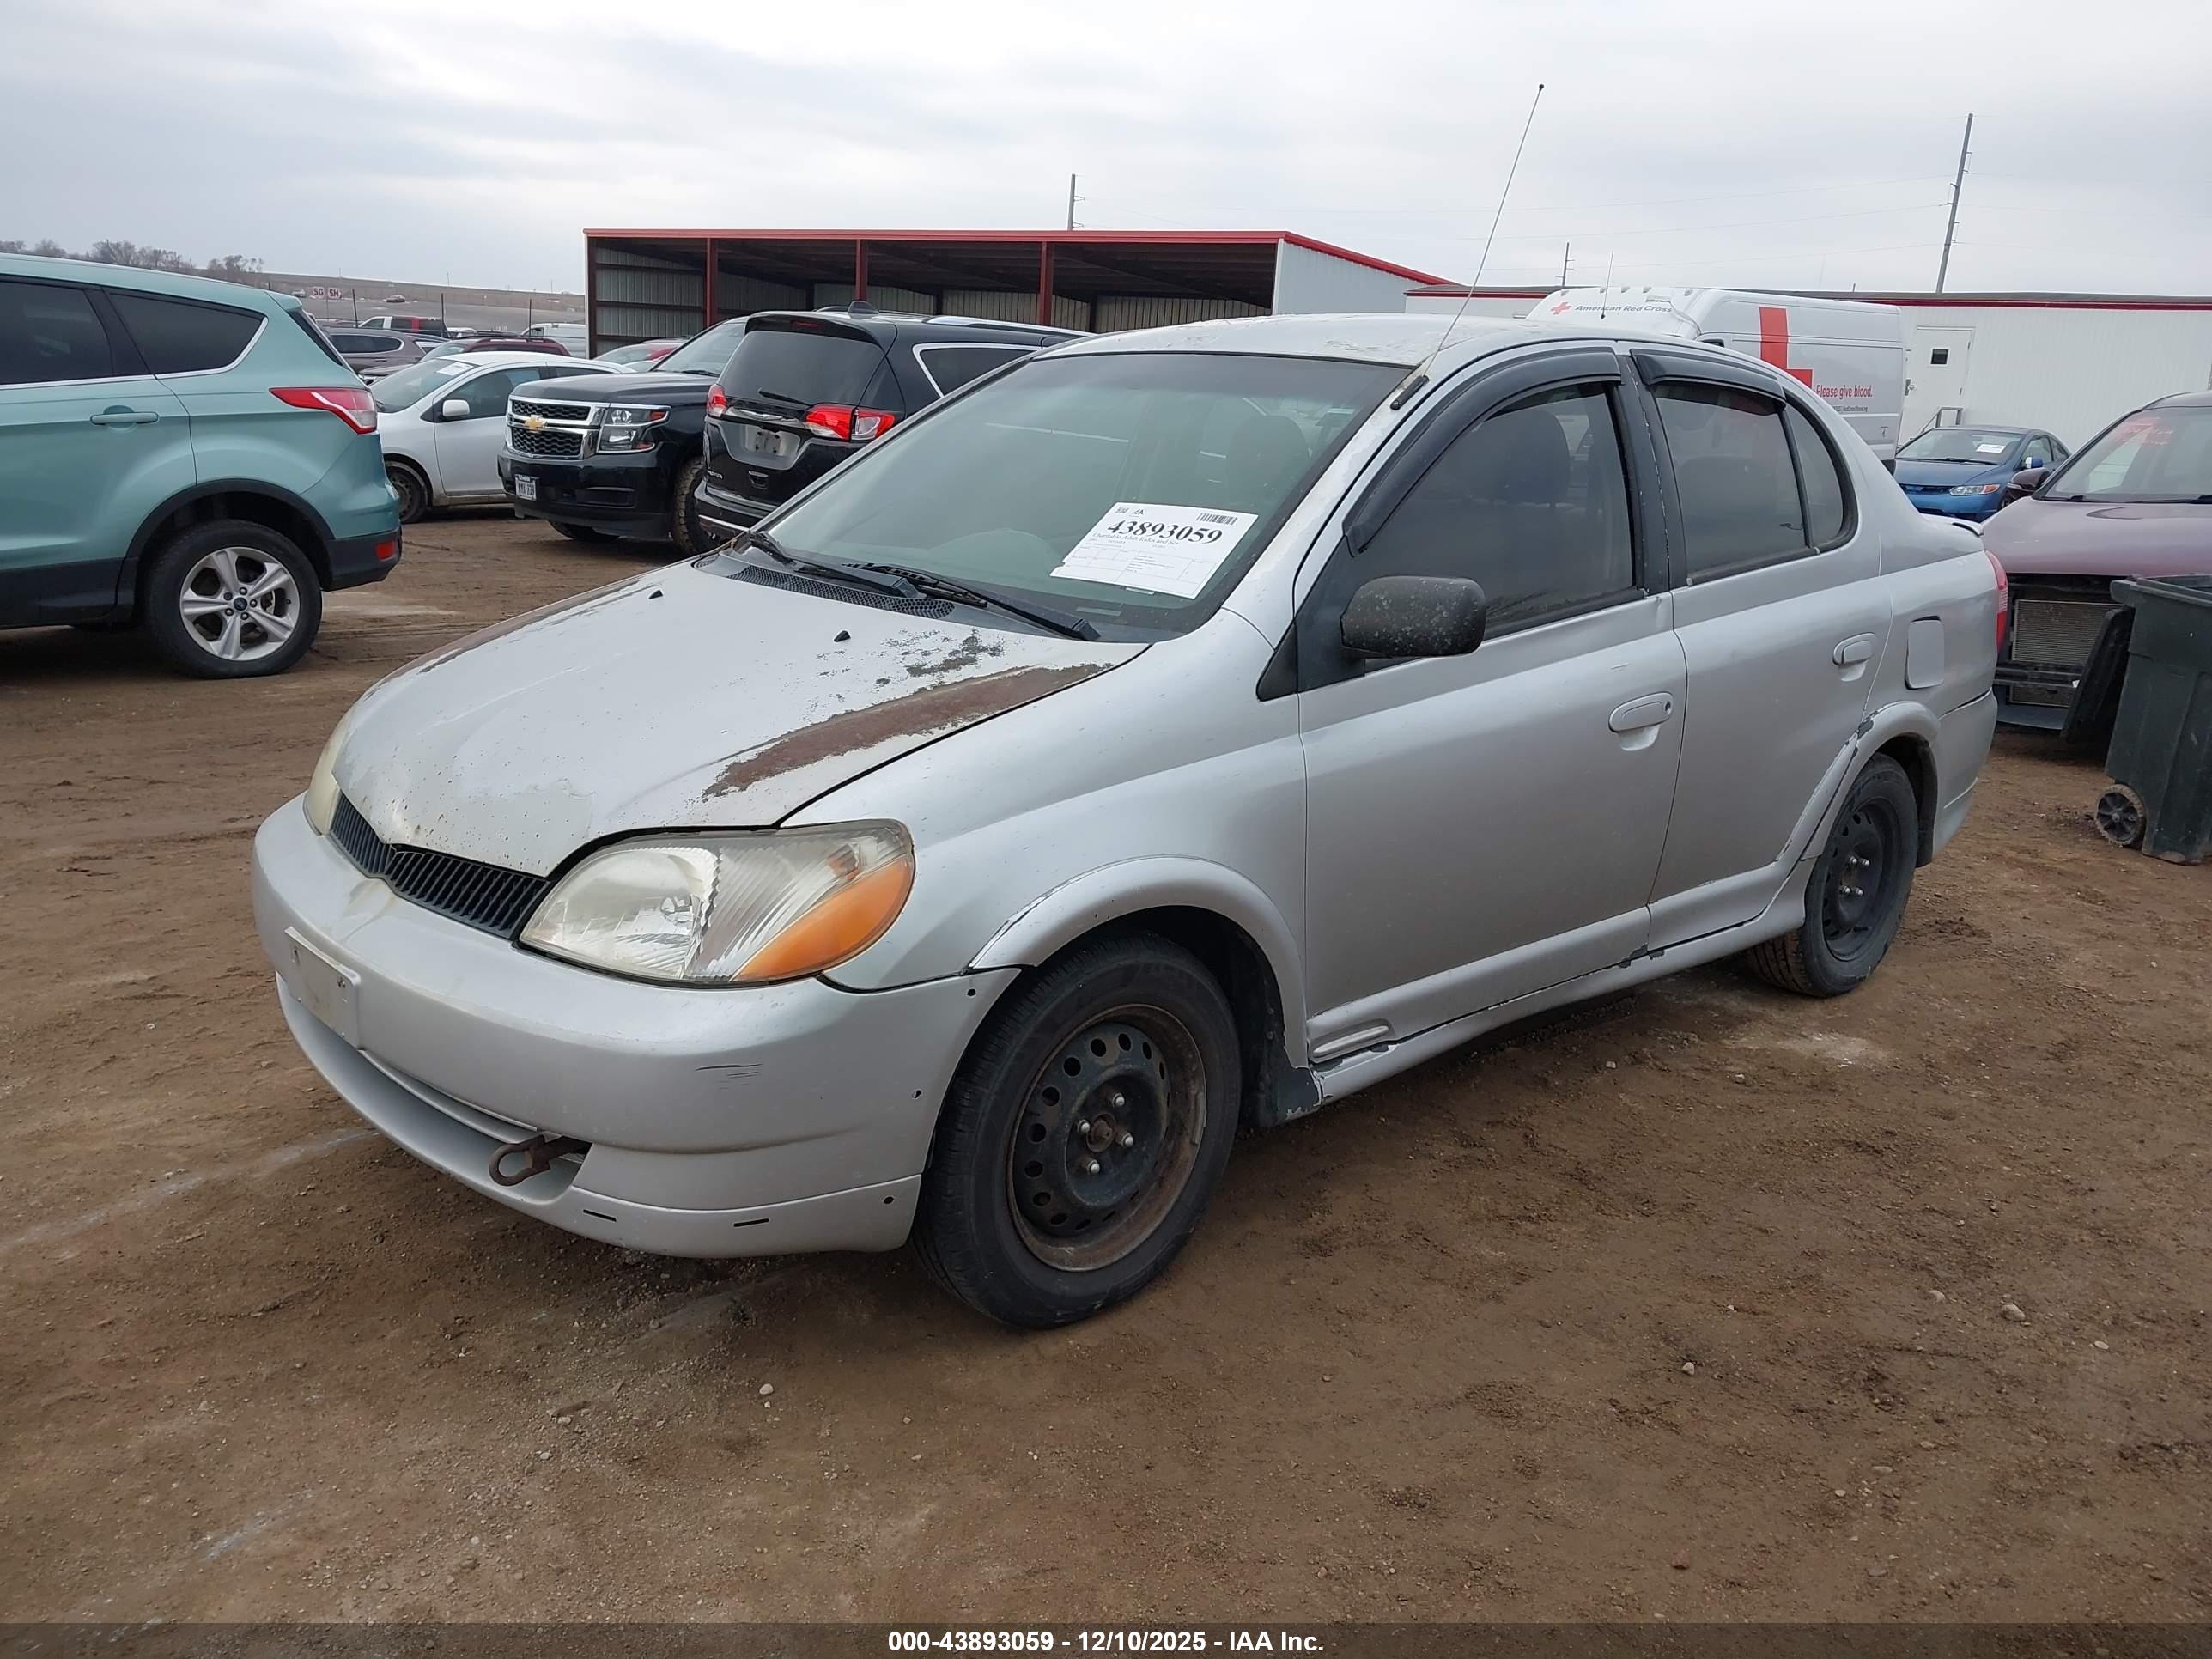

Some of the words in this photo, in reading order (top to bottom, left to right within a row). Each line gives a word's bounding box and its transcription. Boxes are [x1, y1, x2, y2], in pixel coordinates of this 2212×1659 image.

[1816, 384, 1838, 398] Please
[1839, 385, 1852, 400] give
[1854, 385, 1873, 398] blood.
[1107, 520, 1223, 544] 43893059
